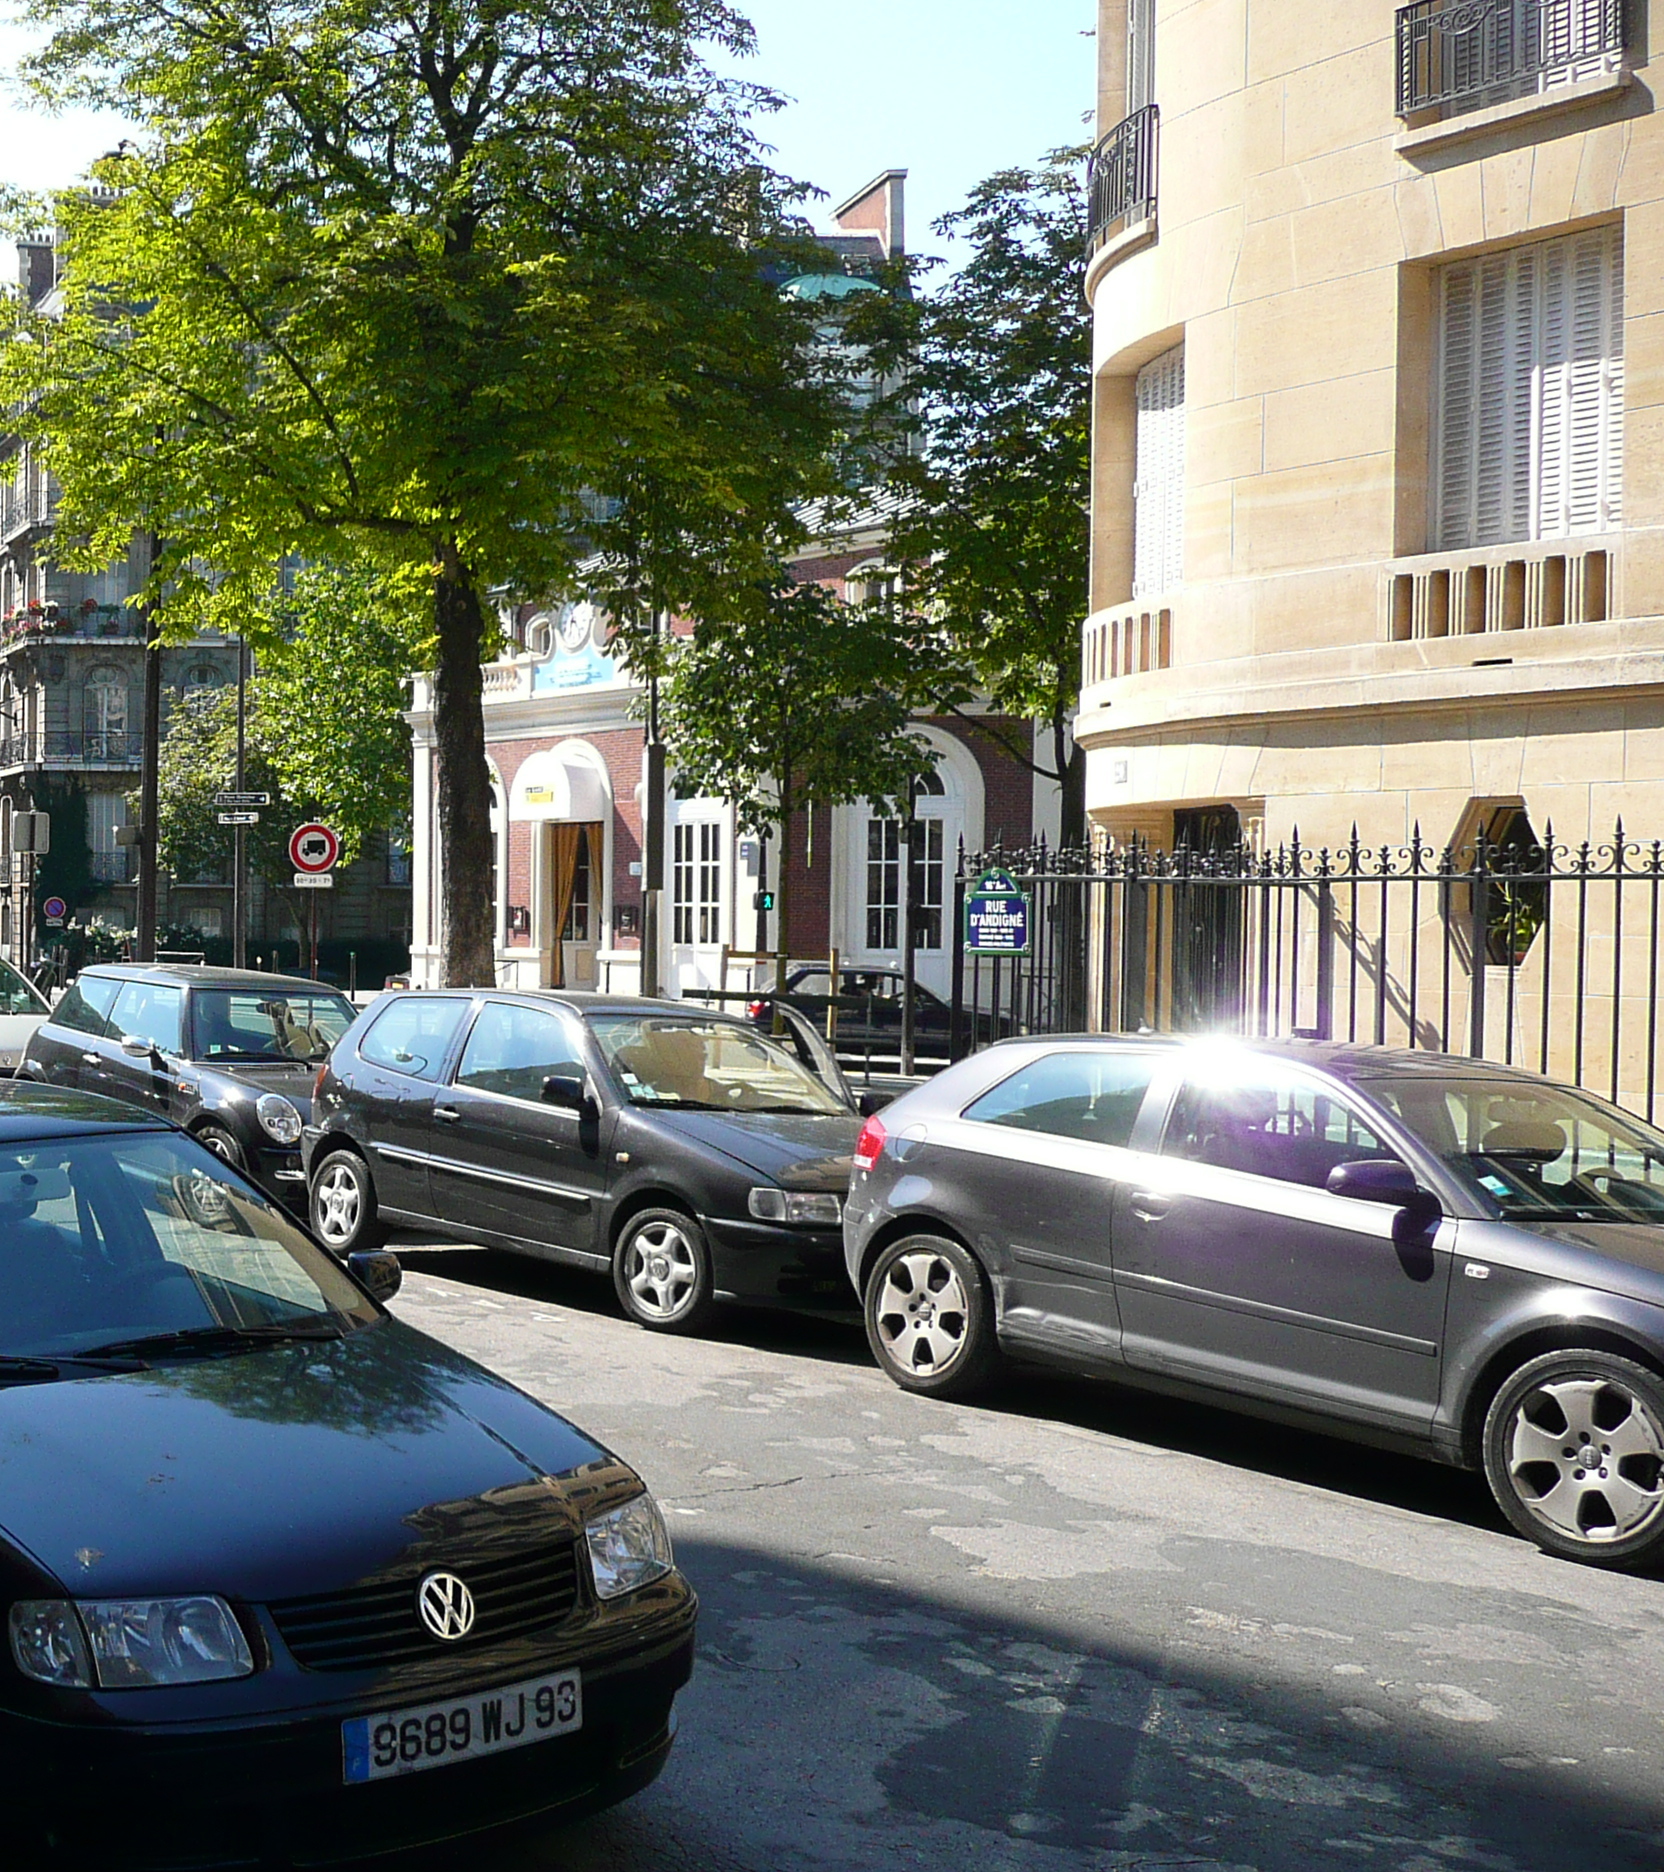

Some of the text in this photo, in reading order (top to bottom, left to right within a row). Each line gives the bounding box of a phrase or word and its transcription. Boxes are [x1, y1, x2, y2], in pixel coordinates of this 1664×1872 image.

[985, 900, 1007, 913] RUE
[970, 912, 1024, 927] D'ANDIGNÉ
[373, 1680, 576, 1767] 9689 WJ 93
